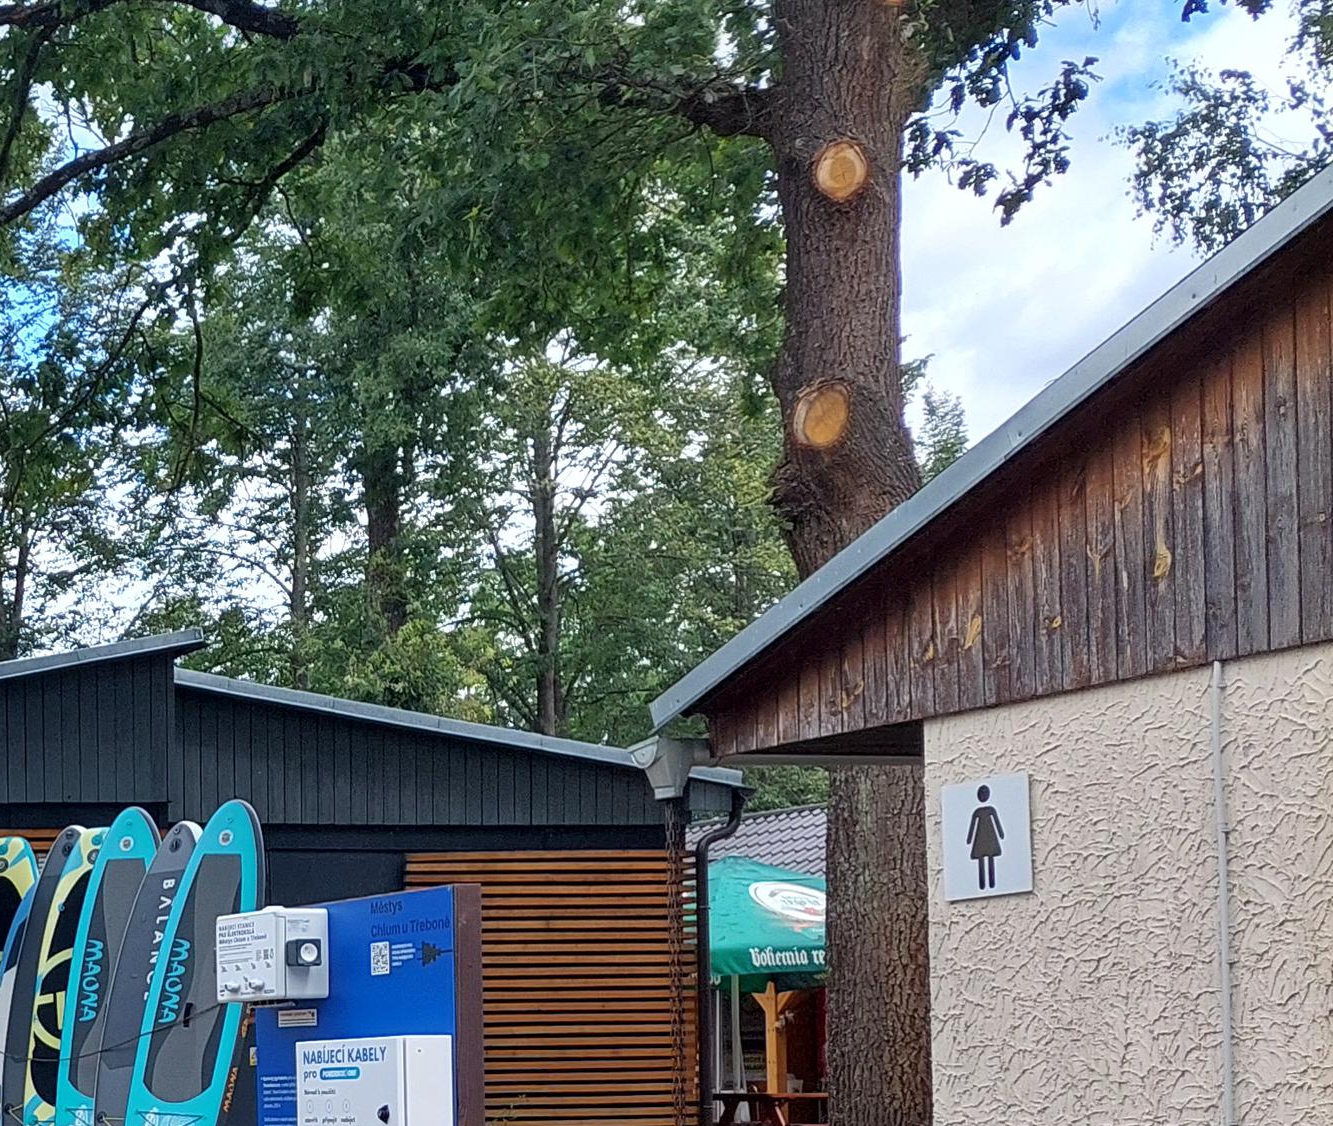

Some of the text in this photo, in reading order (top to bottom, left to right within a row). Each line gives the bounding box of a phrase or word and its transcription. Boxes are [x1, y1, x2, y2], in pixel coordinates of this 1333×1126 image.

[370, 901, 403, 915] Městys
[371, 915, 450, 938] Chlum u Třeboně
[749, 946, 826, 967] Bohemia re
[303, 1044, 387, 1066] NABÍJECÍ KABELY
[303, 1070, 317, 1082] pro
